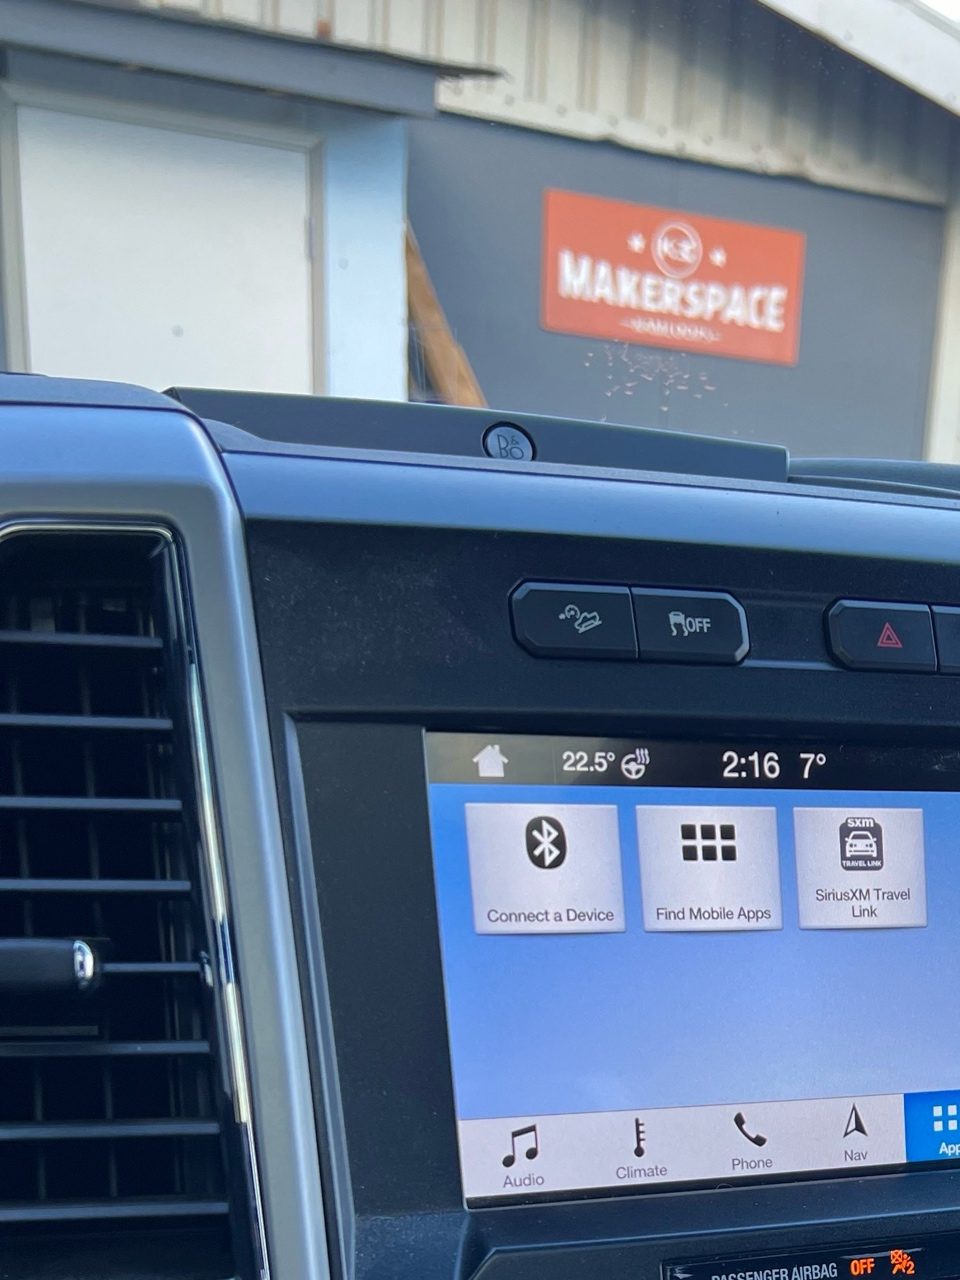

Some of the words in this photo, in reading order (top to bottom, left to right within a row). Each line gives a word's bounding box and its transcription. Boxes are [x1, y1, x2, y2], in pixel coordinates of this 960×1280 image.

[558, 248, 788, 332] MAKERSPACE
[687, 617, 711, 634] OFF
[722, 751, 781, 779] 2:16
[799, 752, 827, 779] 7°
[847, 818, 874, 828] sxm
[815, 888, 870, 902] SiriusXM
[873, 888, 911, 901] Travel
[487, 909, 549, 923] Connect
[553, 912, 563, 922] a
[566, 908, 615, 922] Device
[656, 907, 686, 921] Find
[689, 907, 734, 921] Mobile
[737, 907, 772, 922] Apps
[851, 905, 878, 918] Link
[844, 1150, 868, 1162] Nav
[731, 1157, 773, 1171] Phone
[615, 1165, 668, 1180] Climate
[503, 1173, 545, 1188] Audio
[850, 1257, 875, 1276] OFF
